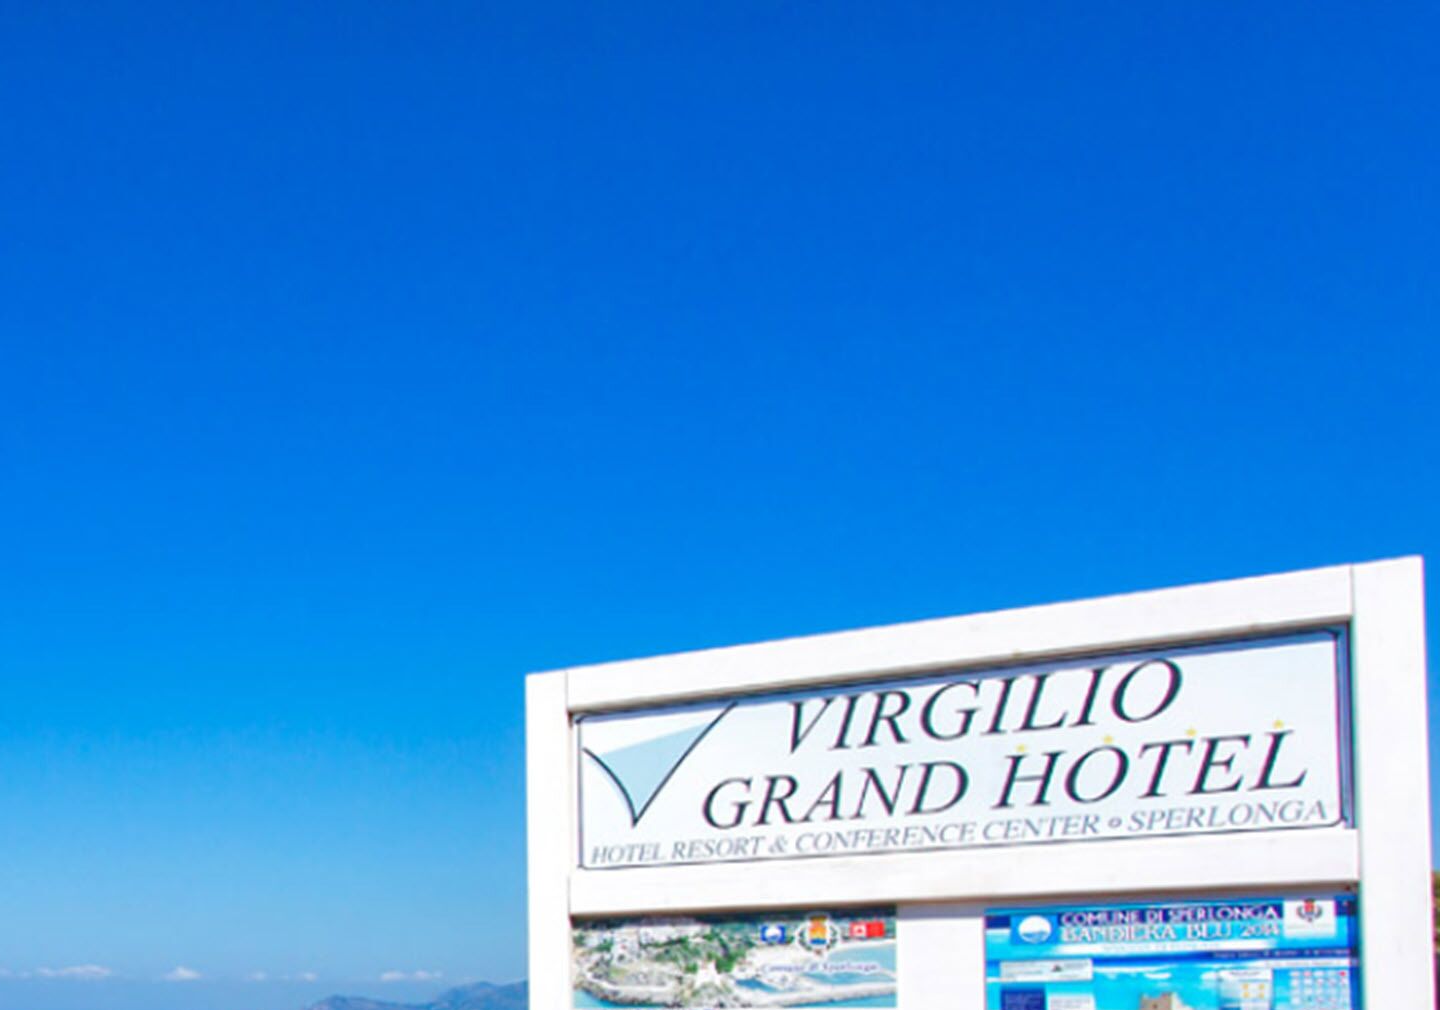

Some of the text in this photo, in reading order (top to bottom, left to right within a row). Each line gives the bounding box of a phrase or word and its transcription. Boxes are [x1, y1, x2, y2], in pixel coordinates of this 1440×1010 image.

[789, 658, 1183, 754] VIRGILIO
[702, 729, 1307, 829] GRAND HOTEL
[591, 799, 1329, 865] HOTEL RESORT & CONFERENCE CENTER SPERLONGA
[1061, 903, 1279, 926] COMUNE DI SPERLONGA
